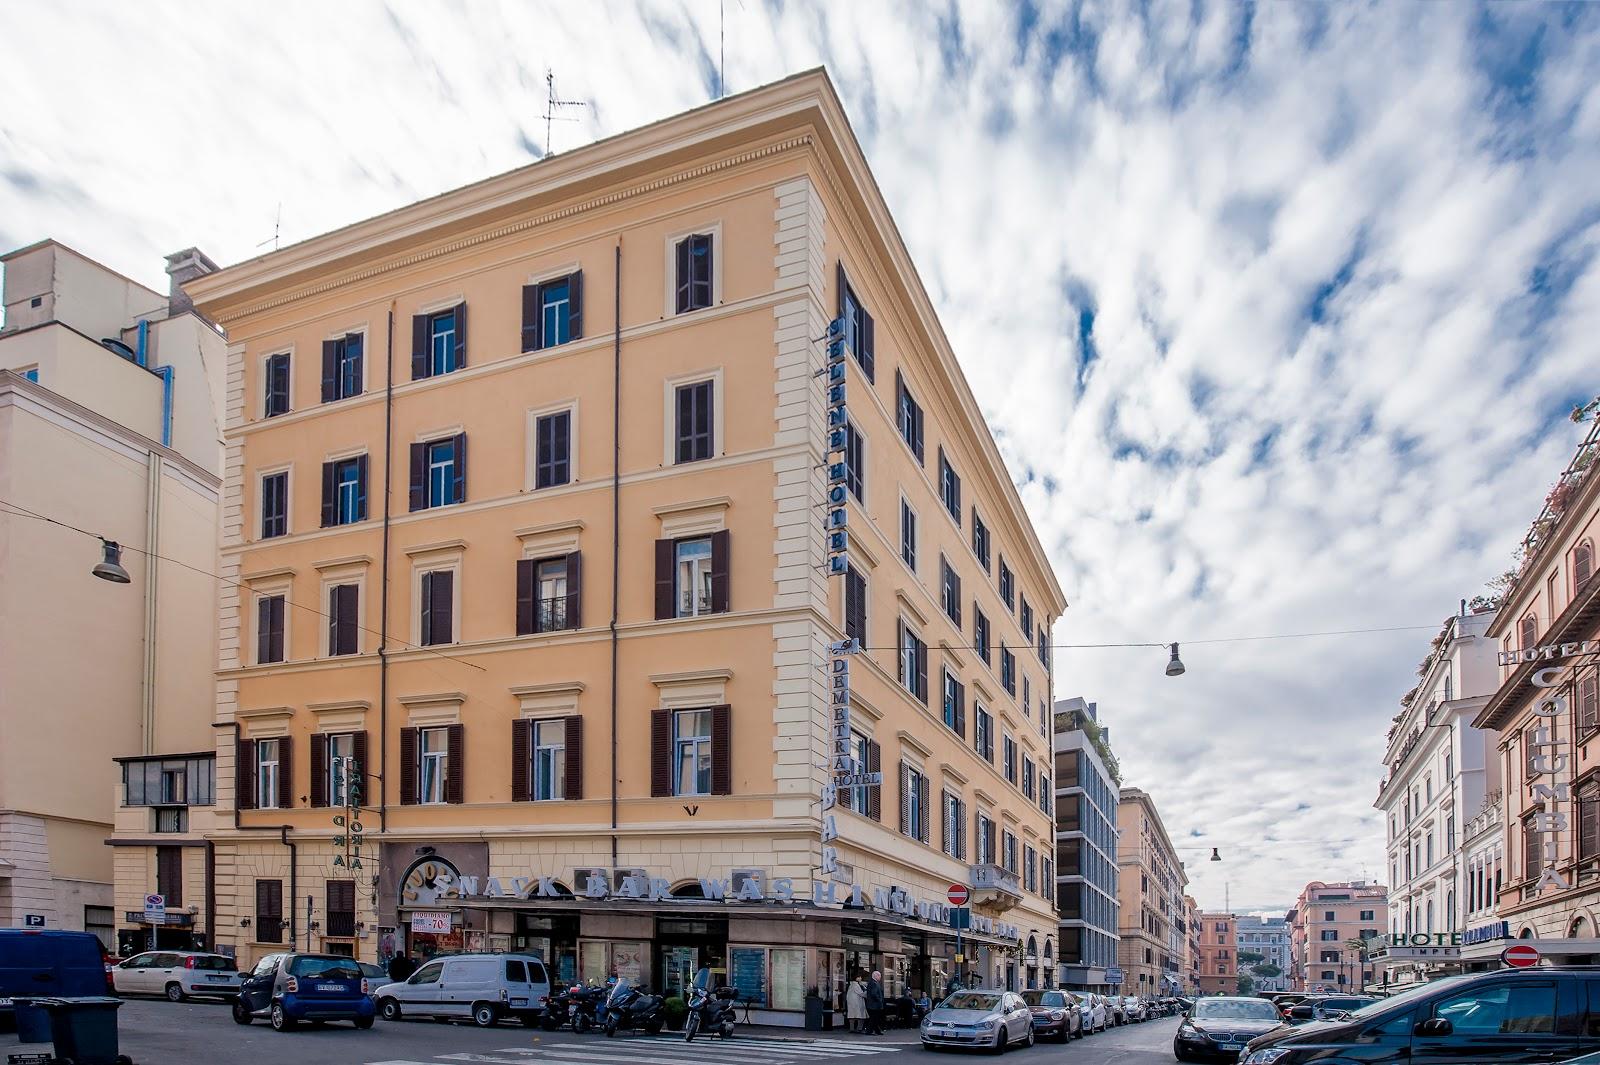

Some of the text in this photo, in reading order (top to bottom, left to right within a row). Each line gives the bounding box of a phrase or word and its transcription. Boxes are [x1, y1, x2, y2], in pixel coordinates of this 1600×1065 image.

[829, 318, 847, 573] SELENE HOTEL
[1500, 640, 1600, 665] HOTEL
[832, 658, 849, 770] DEMETRA
[833, 772, 880, 787] HOTEL
[1531, 666, 1571, 890] COLUMBIA
[821, 783, 838, 874] BAR
[433, 874, 561, 899] SNACK
[586, 876, 673, 899] BAR
[1392, 932, 1461, 946] HOTE
